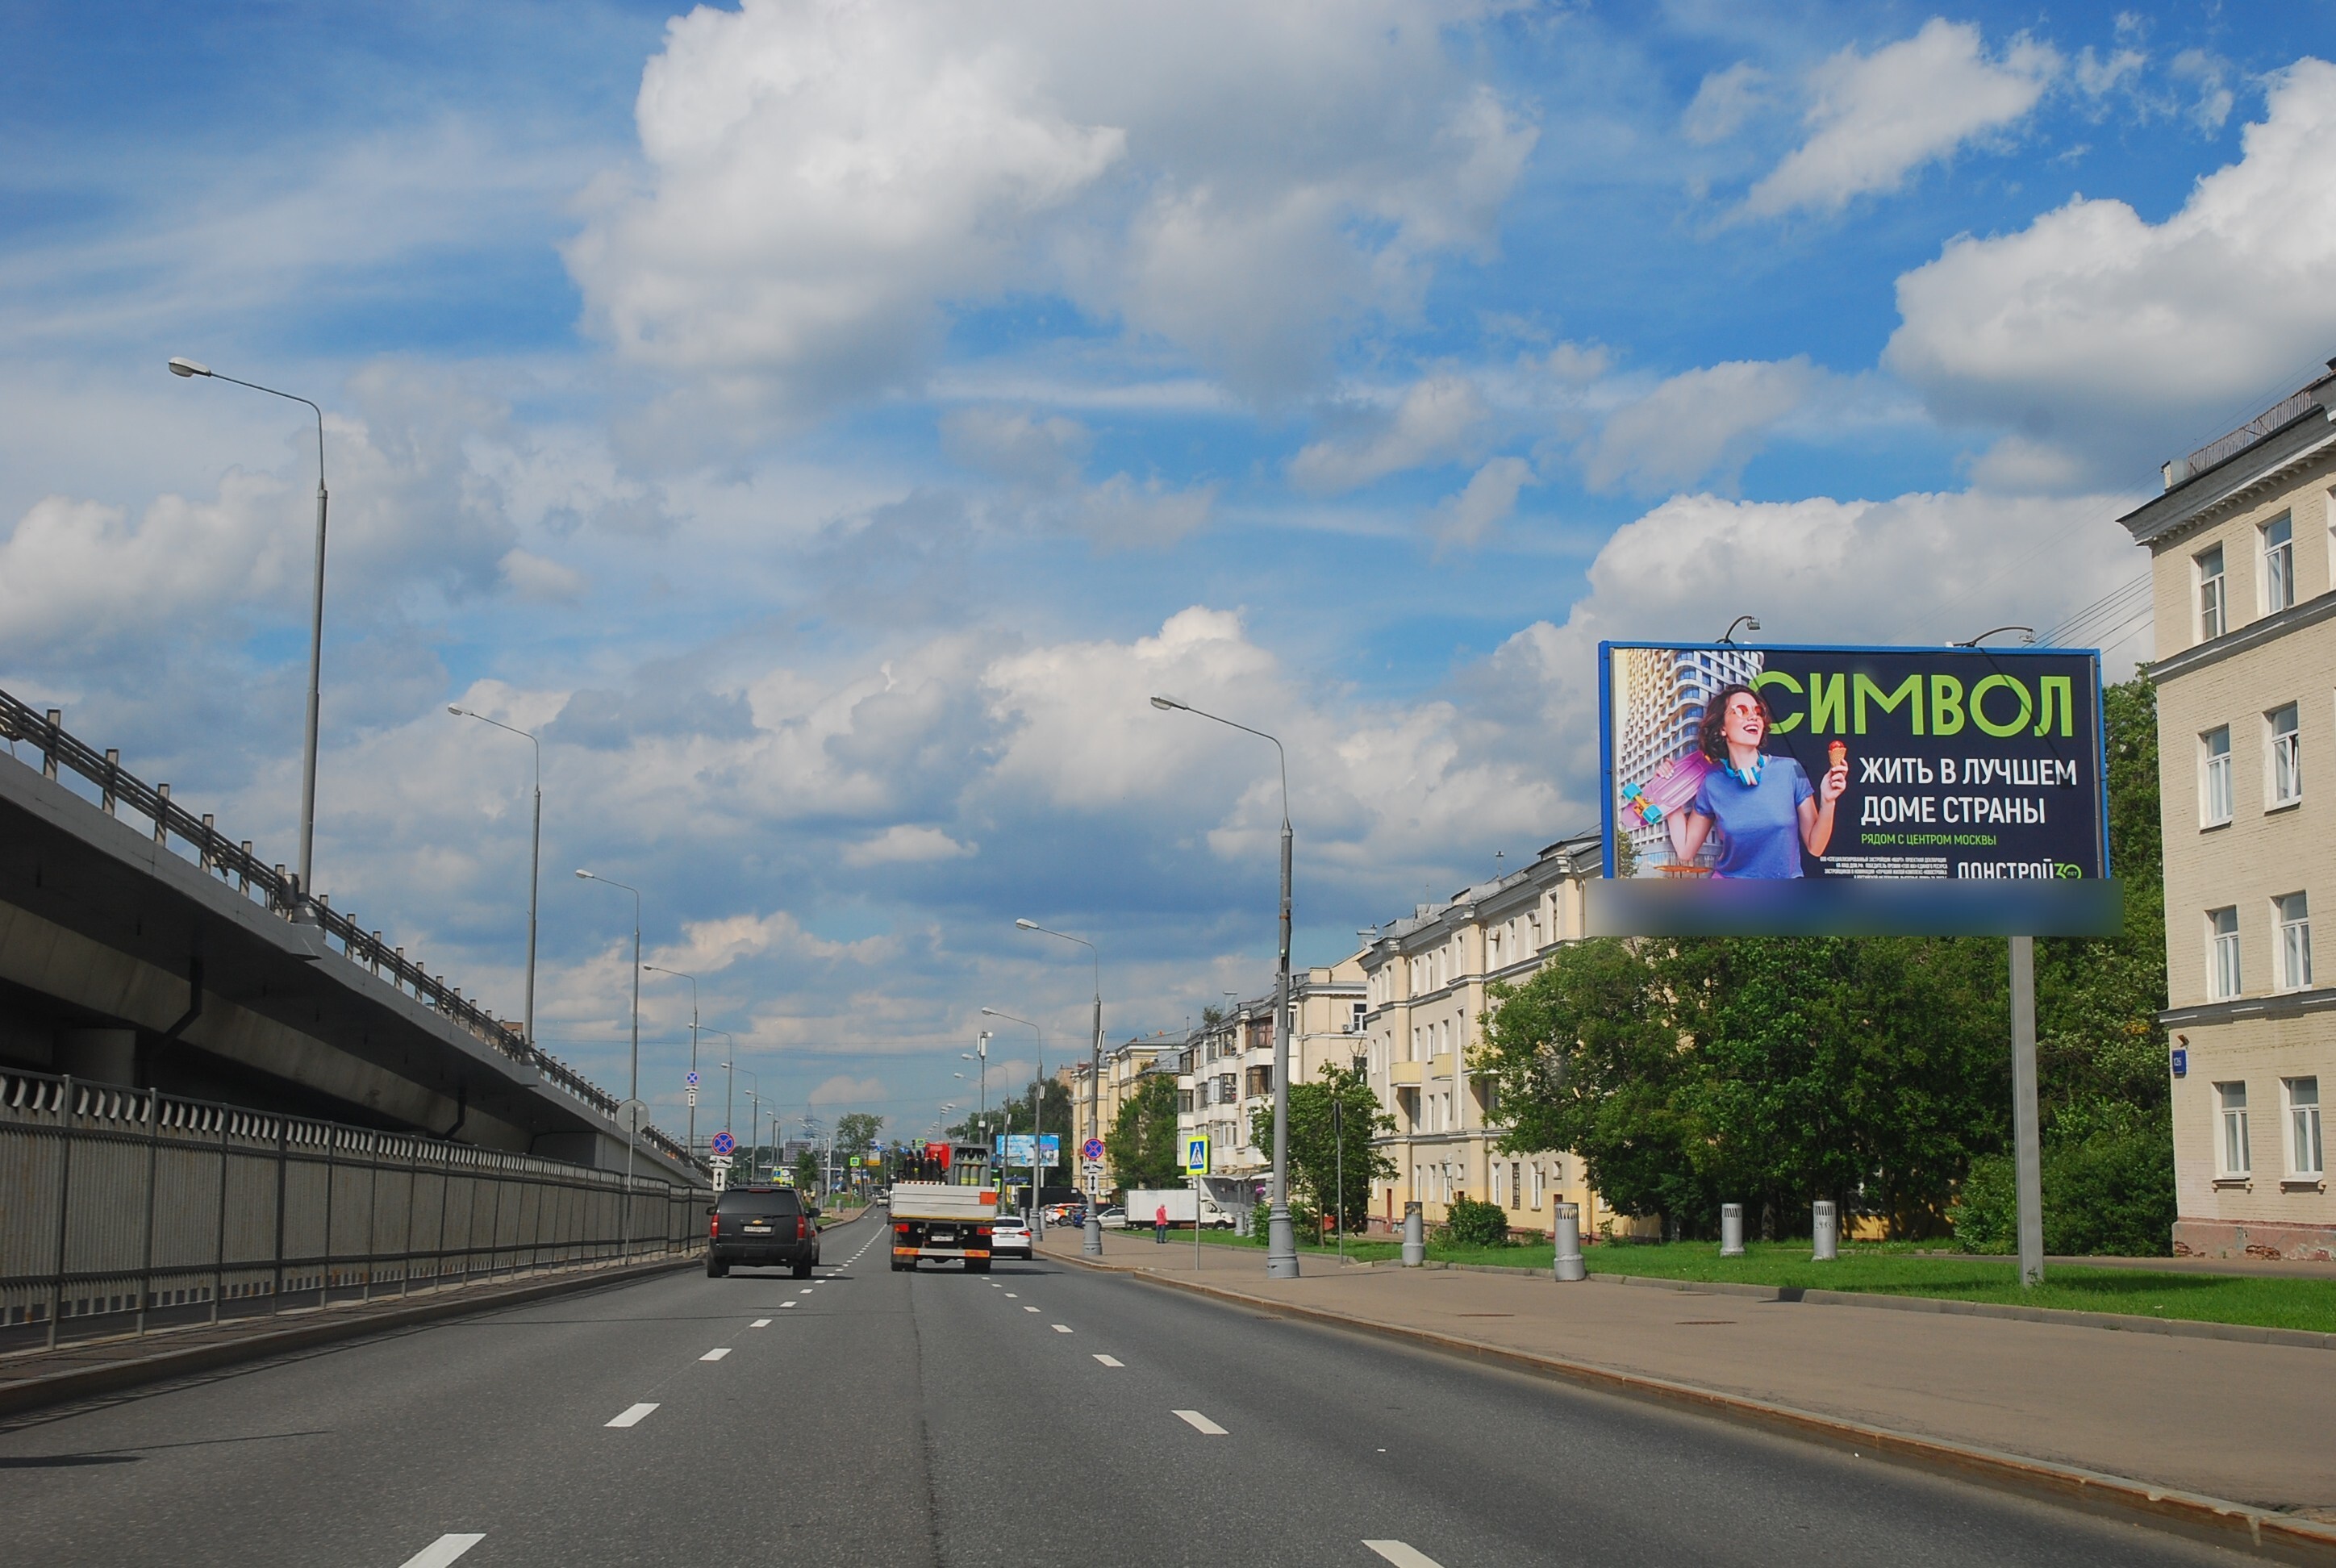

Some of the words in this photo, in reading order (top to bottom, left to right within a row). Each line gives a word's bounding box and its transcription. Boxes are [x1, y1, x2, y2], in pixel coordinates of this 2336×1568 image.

[1748, 671, 2074, 737] СИМВОЛ
[1859, 757, 1933, 784] ЖИТЬ
[1940, 758, 1957, 784] В
[1963, 758, 2077, 786] ЛУЧШЕМ
[1860, 796, 1936, 826] ДОМЕ
[1943, 796, 2046, 824] СТРАНЫ
[1861, 833, 1896, 845] РЯДОМ
[1897, 834, 1904, 844] С
[1906, 834, 1952, 845] ЦЕНТРОМ
[1954, 834, 1996, 845] МОСКВЫ
[1958, 858, 2054, 878] ДОНСТРОЙ
